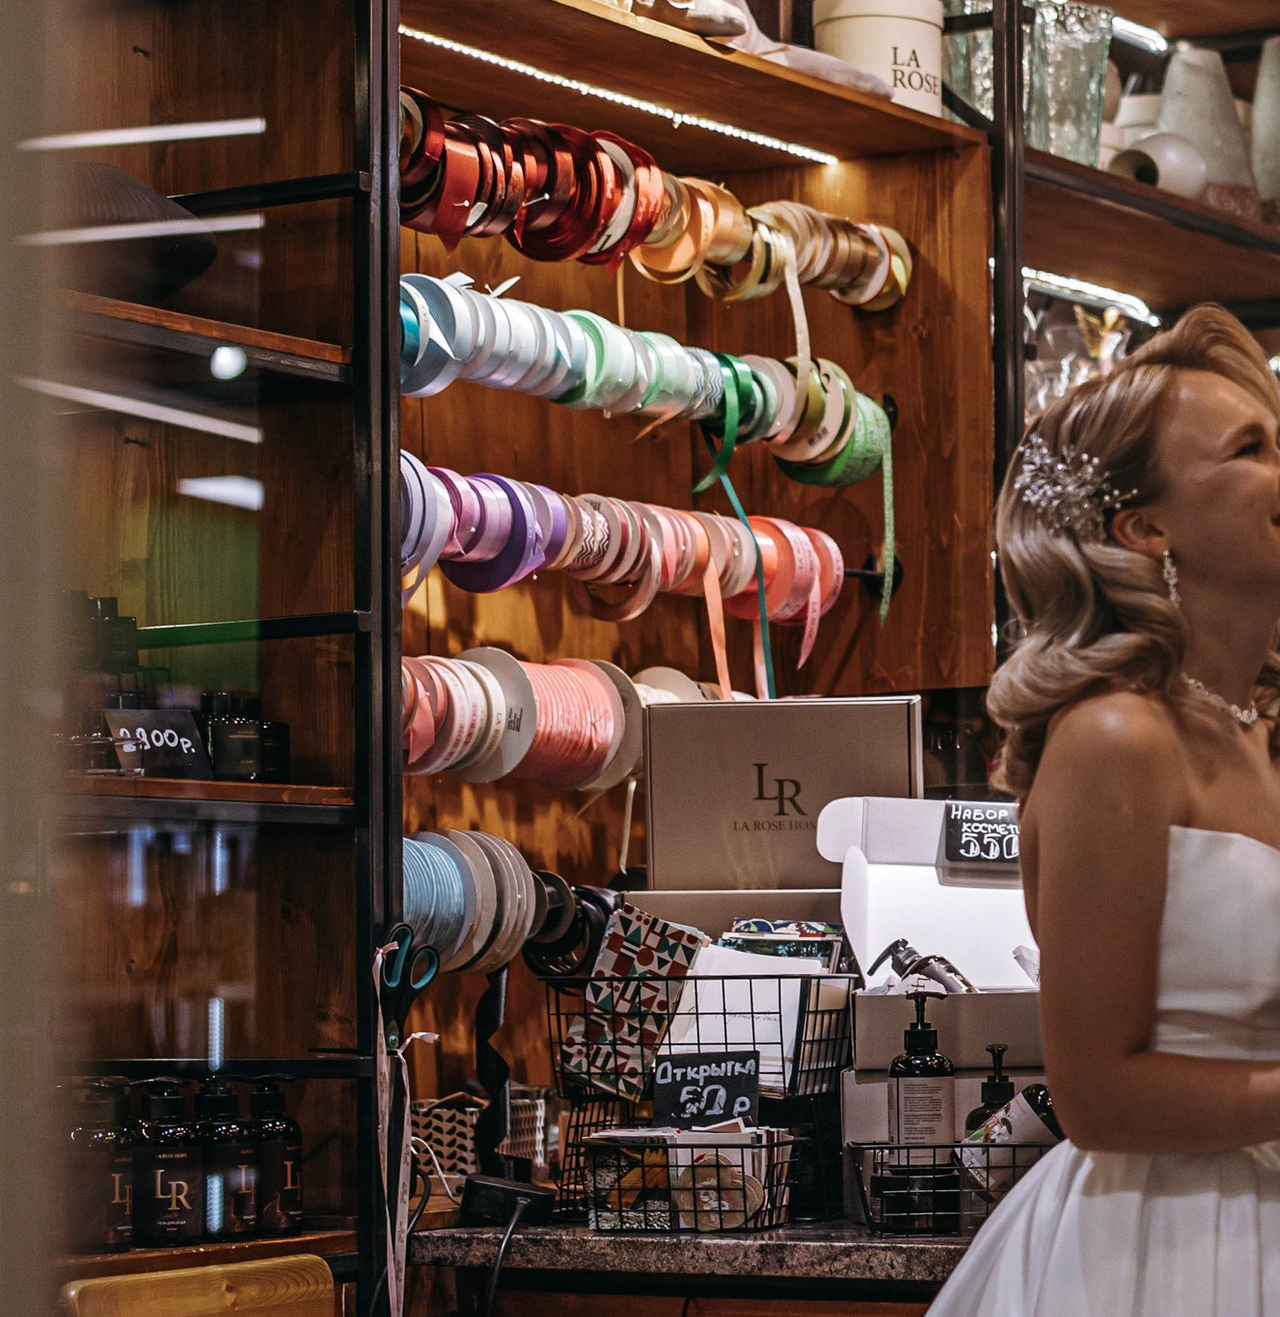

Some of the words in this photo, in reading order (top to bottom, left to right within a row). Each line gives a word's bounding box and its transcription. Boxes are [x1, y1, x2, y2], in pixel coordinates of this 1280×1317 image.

[891, 46, 921, 70] LA
[891, 68, 940, 96] ROSE
[752, 762, 807, 816] LR
[951, 804, 1009, 821] НАБОР
[733, 821, 750, 832] LA
[753, 820, 786, 832] ROSE
[154, 1169, 192, 1211] LR
